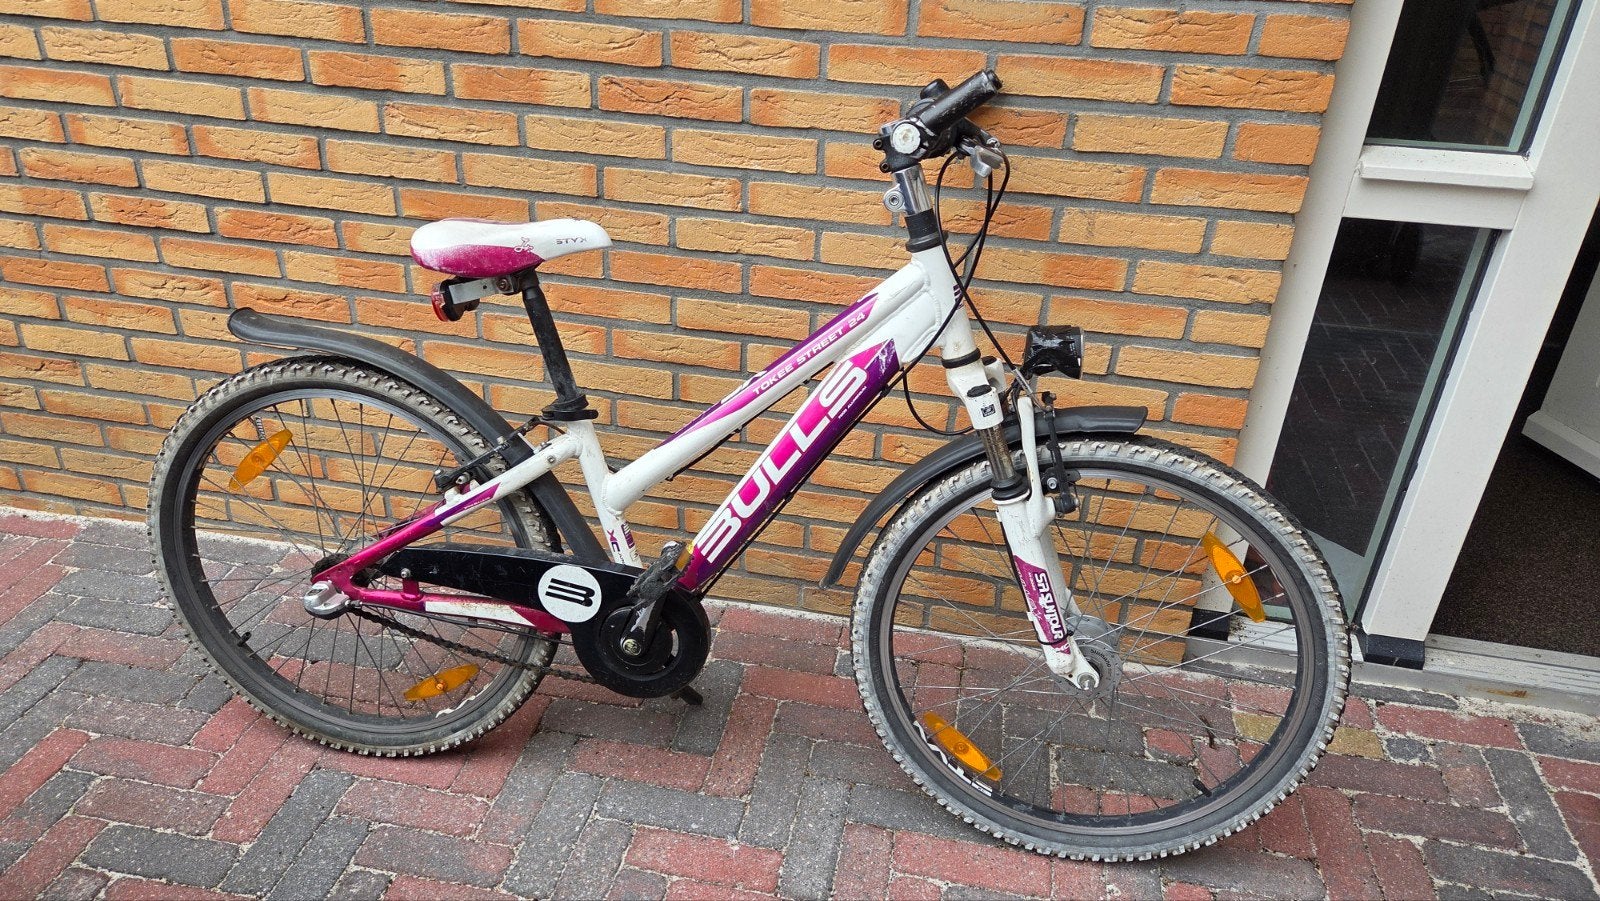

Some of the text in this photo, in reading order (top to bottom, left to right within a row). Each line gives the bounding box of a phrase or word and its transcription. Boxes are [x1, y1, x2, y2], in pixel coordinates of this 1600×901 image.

[753, 312, 866, 395] TOKEE STREET 24
[697, 359, 868, 563] BULLS
